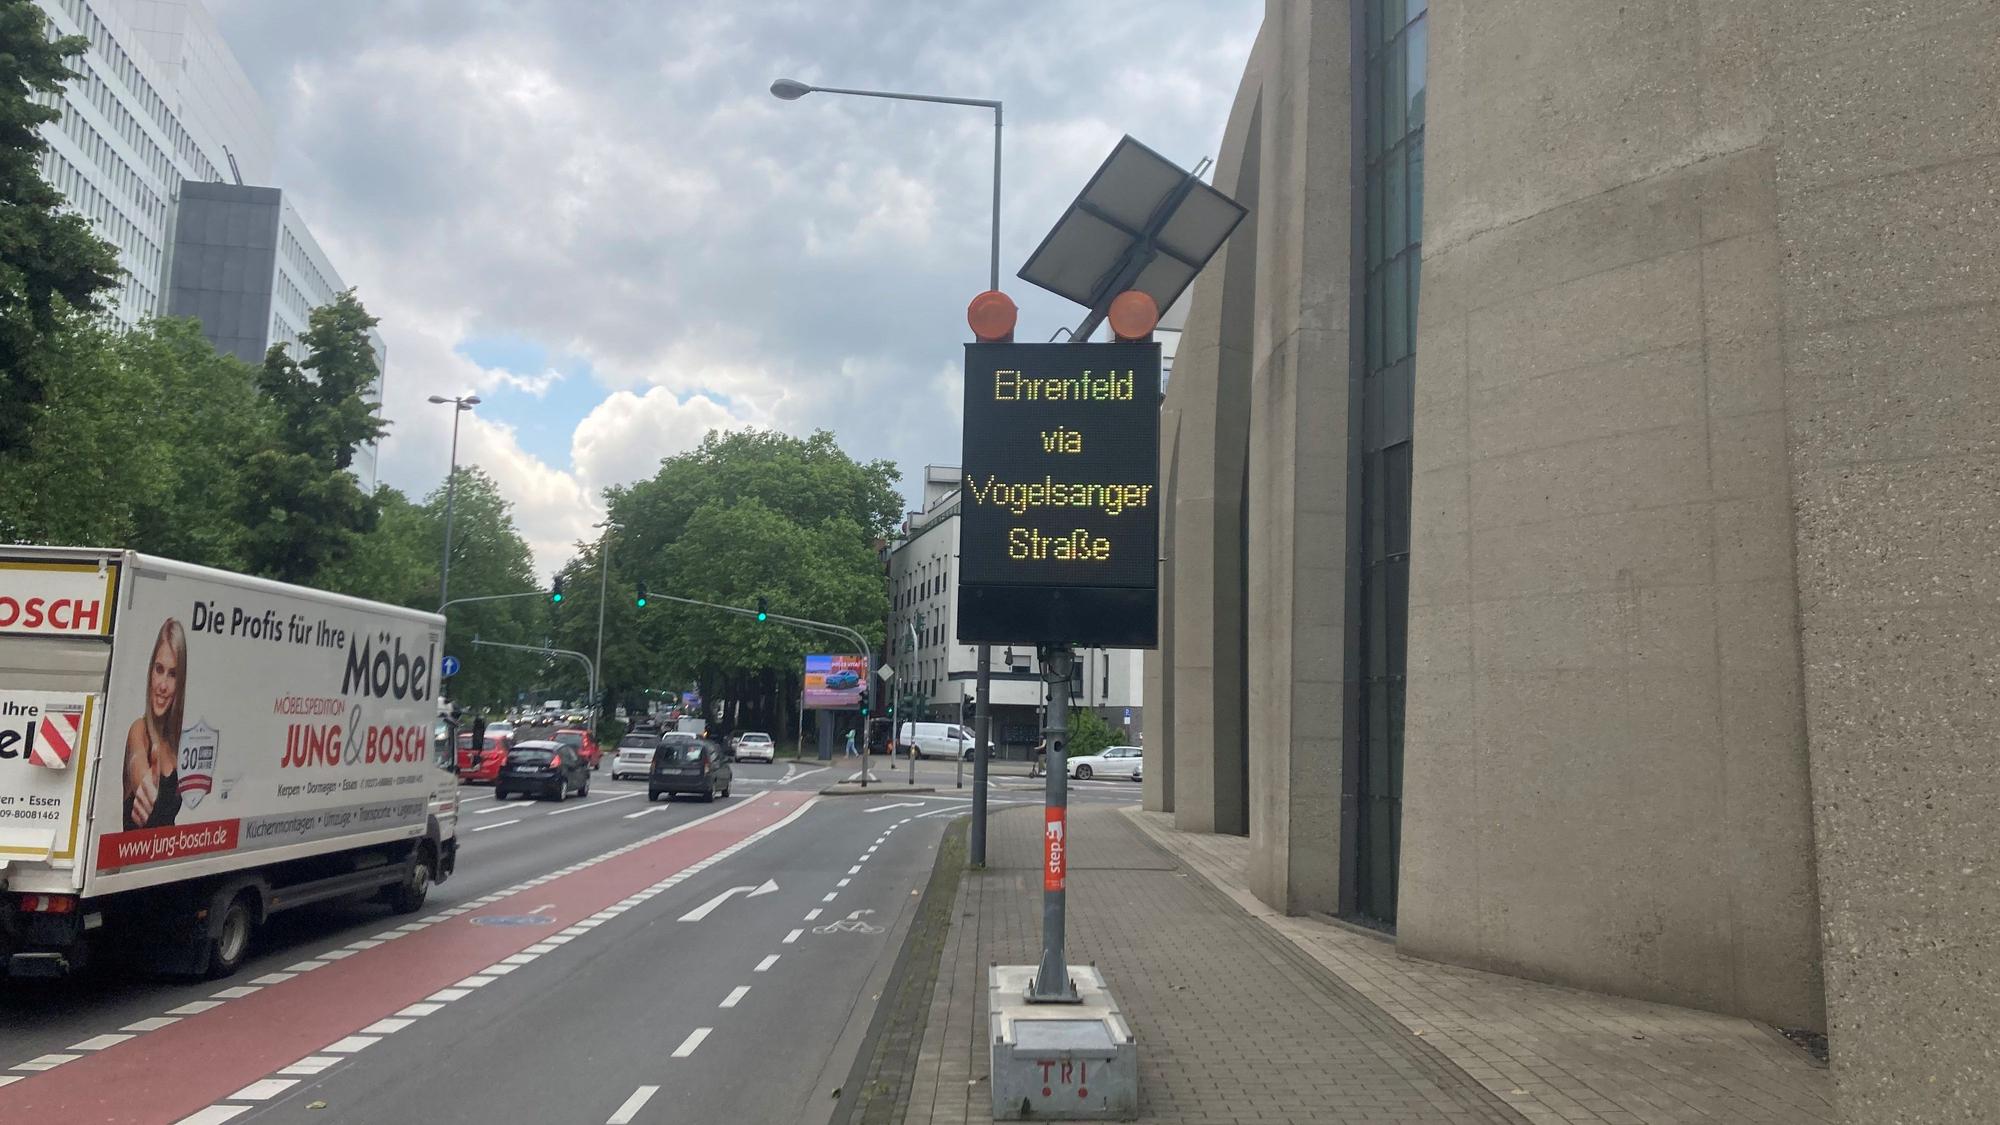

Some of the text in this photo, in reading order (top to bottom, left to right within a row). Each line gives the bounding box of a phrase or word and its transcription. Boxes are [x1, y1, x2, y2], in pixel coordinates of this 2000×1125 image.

[995, 370, 1133, 400] Ehrenfeld
[1041, 426, 1082, 453] via
[967, 474, 1153, 515] Vogelsanger
[1009, 528, 1111, 559] Straße
[191, 601, 345, 649] Die Profis für Ihre
[341, 631, 436, 701] Möbel
[2, 701, 38, 716] Ihre
[281, 704, 427, 768] JUNG & BOSCH
[181, 747, 198, 770] 30
[0, 795, 61, 806] en Essen
[277, 783, 300, 798] Kerpen
[307, 782, 336, 795] Dormagen
